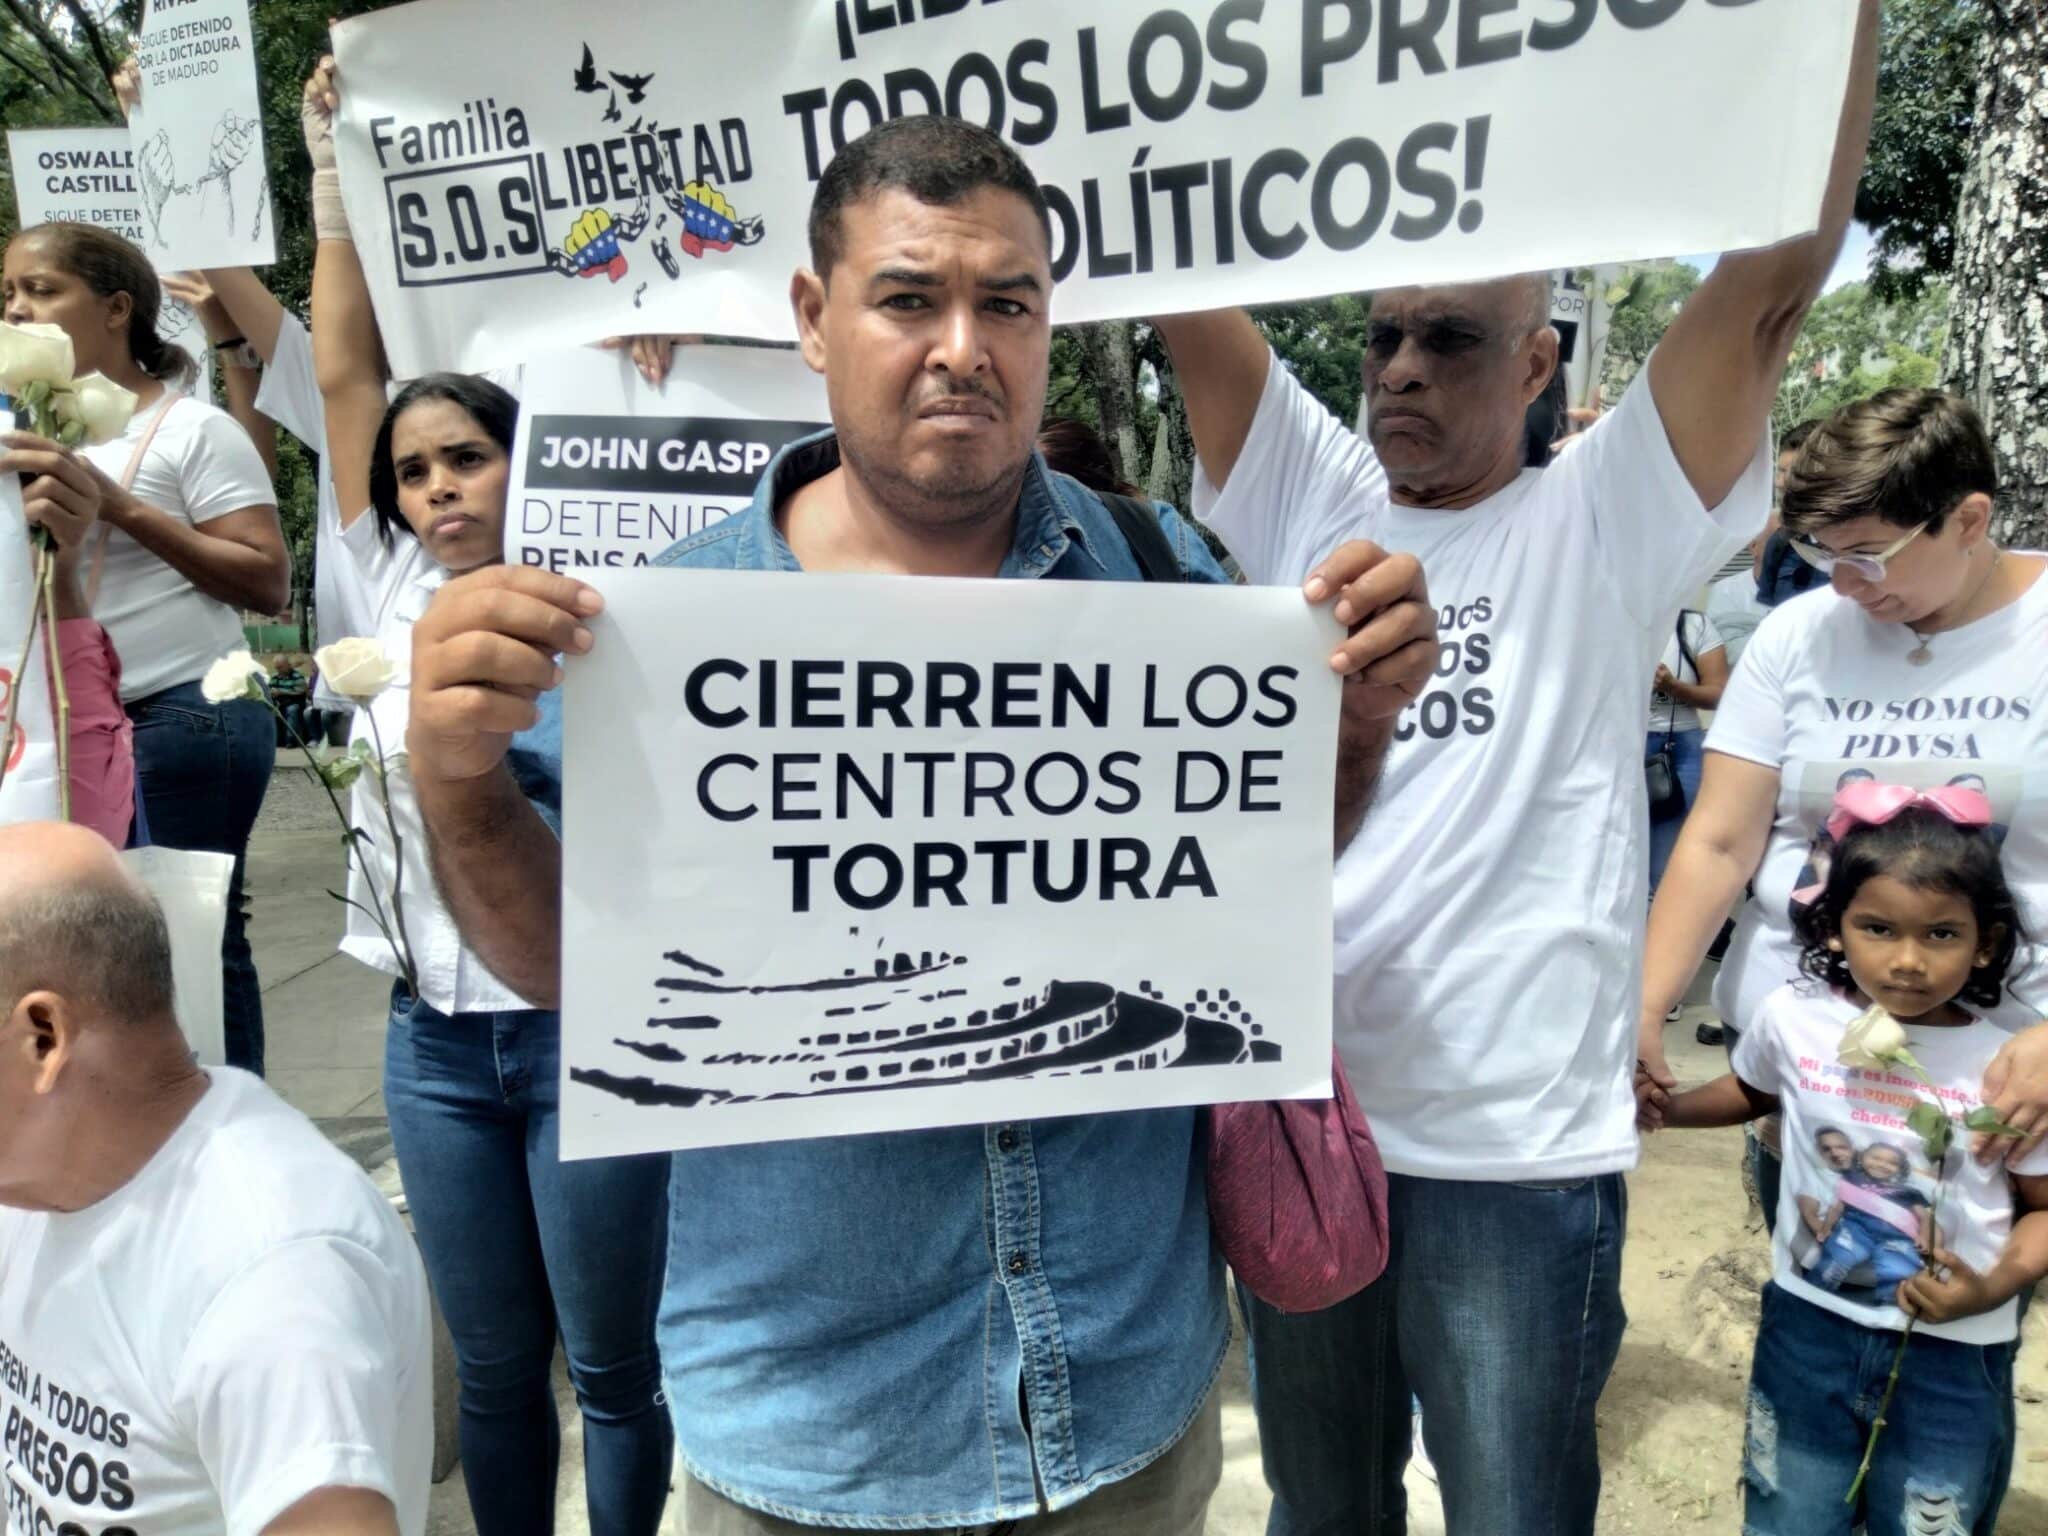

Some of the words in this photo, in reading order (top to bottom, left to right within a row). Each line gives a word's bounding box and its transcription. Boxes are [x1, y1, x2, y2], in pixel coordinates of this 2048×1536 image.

[141, 29, 169, 50] SIGUE
[170, 16, 233, 42] DETENIDO
[169, 35, 241, 62] DICTADURA
[152, 70, 166, 87] DE
[168, 60, 219, 82] MADURO
[1077, 0, 1268, 134] LOS
[1300, 0, 1764, 98] PRE
[369, 98, 530, 168] Familia
[46, 175, 138, 194] CASTILL
[398, 176, 541, 270] S.O.S
[536, 117, 753, 211] LIBERTAD
[540, 436, 648, 470] JOHN
[657, 438, 788, 474] GASP
[684, 657, 1111, 728] CIERREN
[1143, 664, 1300, 729] LOS
[1820, 697, 1873, 722] NO
[1882, 695, 2031, 722] SOMOS
[1841, 733, 1983, 760] PDVSA
[697, 751, 1142, 822] CENTROS
[1174, 750, 1284, 814] DE
[772, 836, 1219, 913] TORTURA
[1798, 1056, 1819, 1072] Mi
[30, 1372, 42, 1412] A
[47, 1381, 131, 1449] TODOS
[4, 1404, 135, 1512] PRESOS
